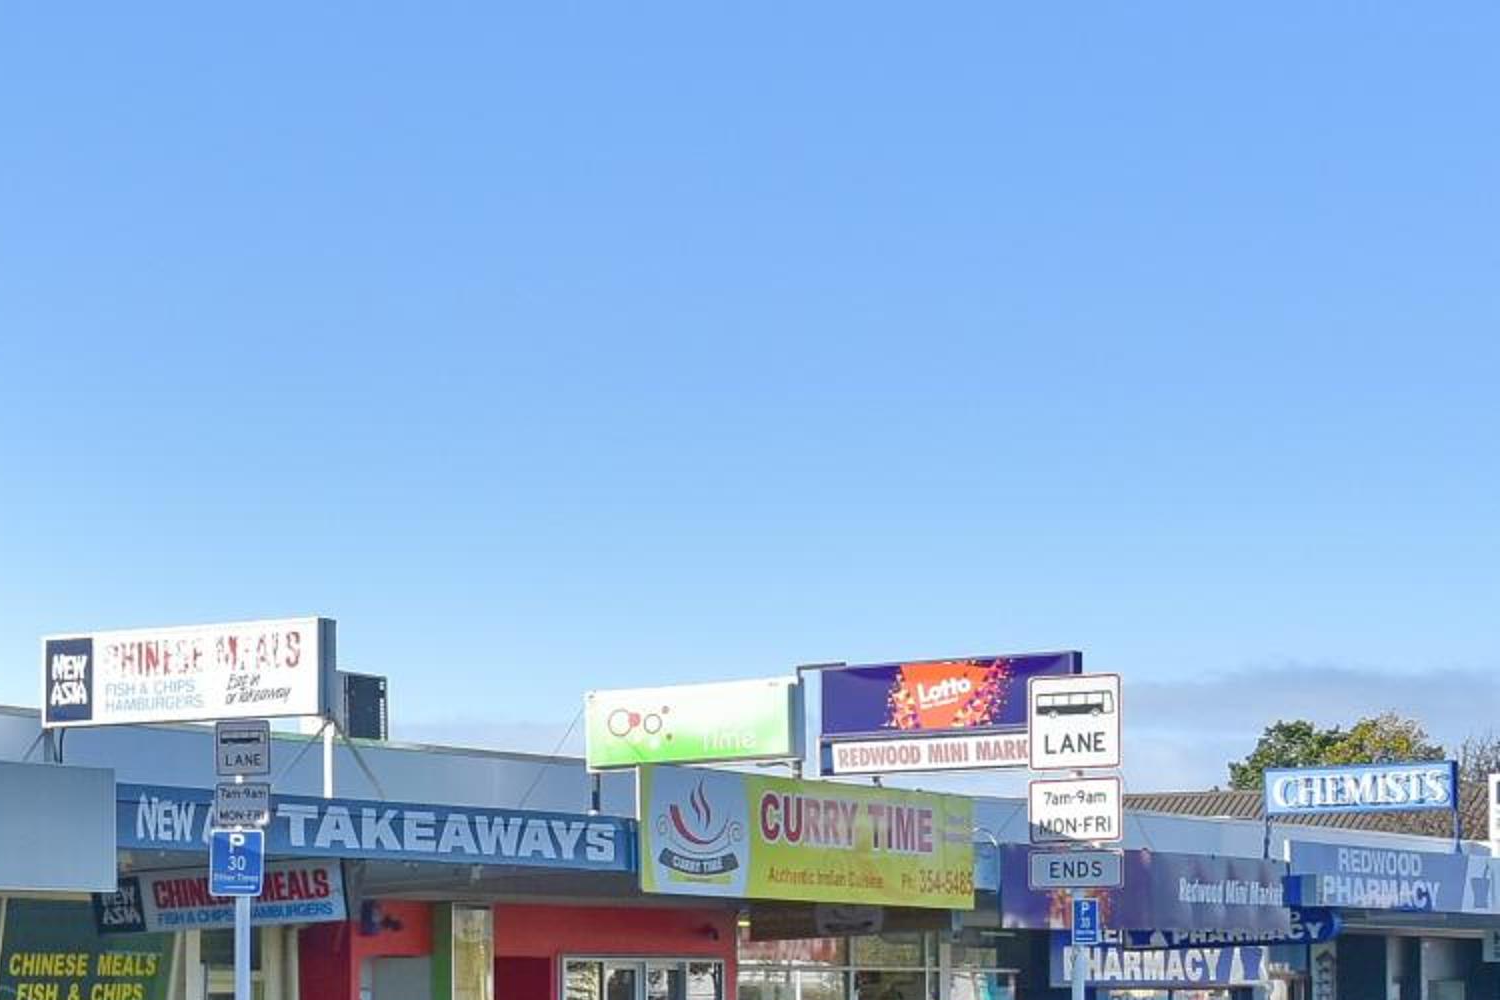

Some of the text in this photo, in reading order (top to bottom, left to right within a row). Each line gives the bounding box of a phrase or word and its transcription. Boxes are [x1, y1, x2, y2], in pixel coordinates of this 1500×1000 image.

[51, 653, 88, 681] NEW
[50, 680, 88, 706] ASIA
[153, 678, 196, 695] CHIPS
[916, 677, 972, 702] Lotto
[837, 738, 1029, 769] REDWOOD MINI MARK
[1043, 731, 1107, 755] LANE
[224, 753, 262, 768] LANE
[1043, 789, 1107, 806] 7am-9am
[1272, 768, 1449, 808] CHEMISTS
[136, 793, 196, 843] NEW
[276, 803, 616, 862] TAKEAWAYS
[759, 793, 933, 853] CURRY TIME
[1038, 815, 1112, 836] MON-FRI
[228, 834, 246, 854] P
[227, 855, 247, 871] 30
[1049, 860, 1103, 879] ENDS
[1338, 847, 1422, 876] REDWOOD
[152, 876, 235, 909] CHINE
[1323, 875, 1441, 909] PHARMACY
[102, 908, 141, 925] ASIA
[250, 902, 334, 920] AMBURGERS
[9, 953, 158, 977] CHINESE MEALS
